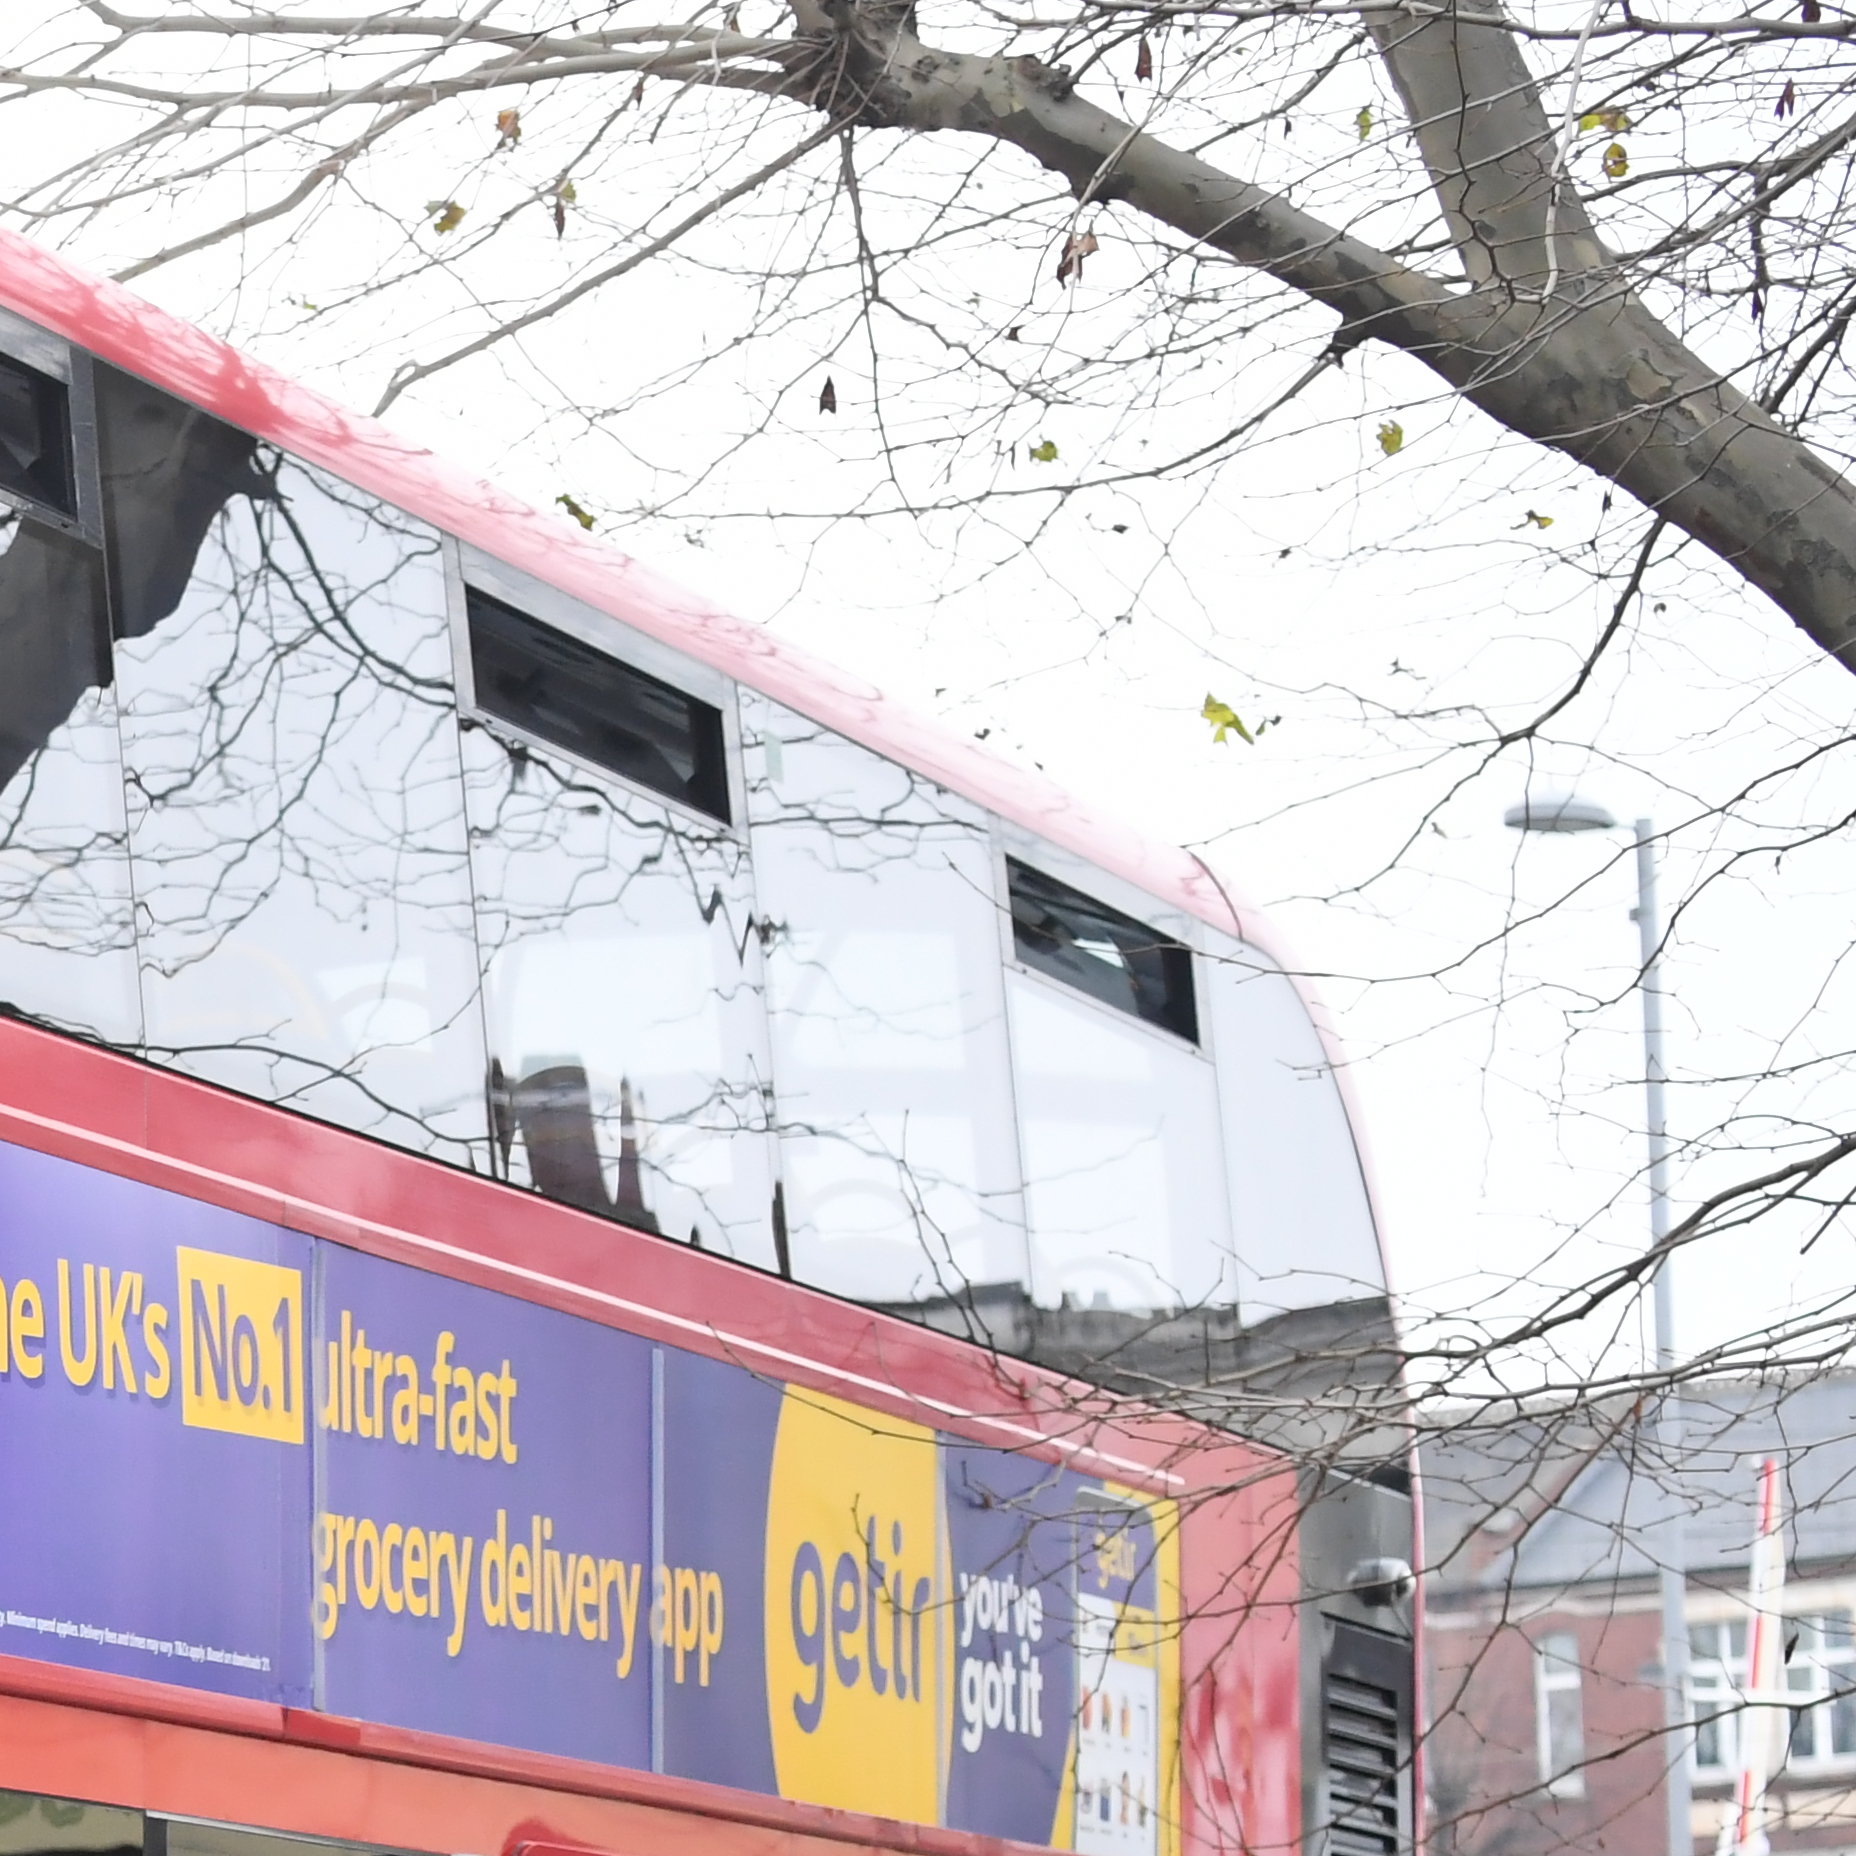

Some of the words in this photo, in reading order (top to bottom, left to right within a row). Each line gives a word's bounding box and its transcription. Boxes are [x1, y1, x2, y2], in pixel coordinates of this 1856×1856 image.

[56, 1257, 172, 1400] UK's
[191, 1275, 293, 1415] No.1
[320, 1310, 518, 1465] ultra-fast
[316, 1511, 473, 1657] grocery
[480, 1509, 642, 1680] delivery
[649, 1561, 724, 1688] app
[789, 1513, 932, 1735] getir
[959, 1571, 1043, 1648] you've
[961, 1651, 1017, 1753] got
[1020, 1640, 1043, 1738] it
